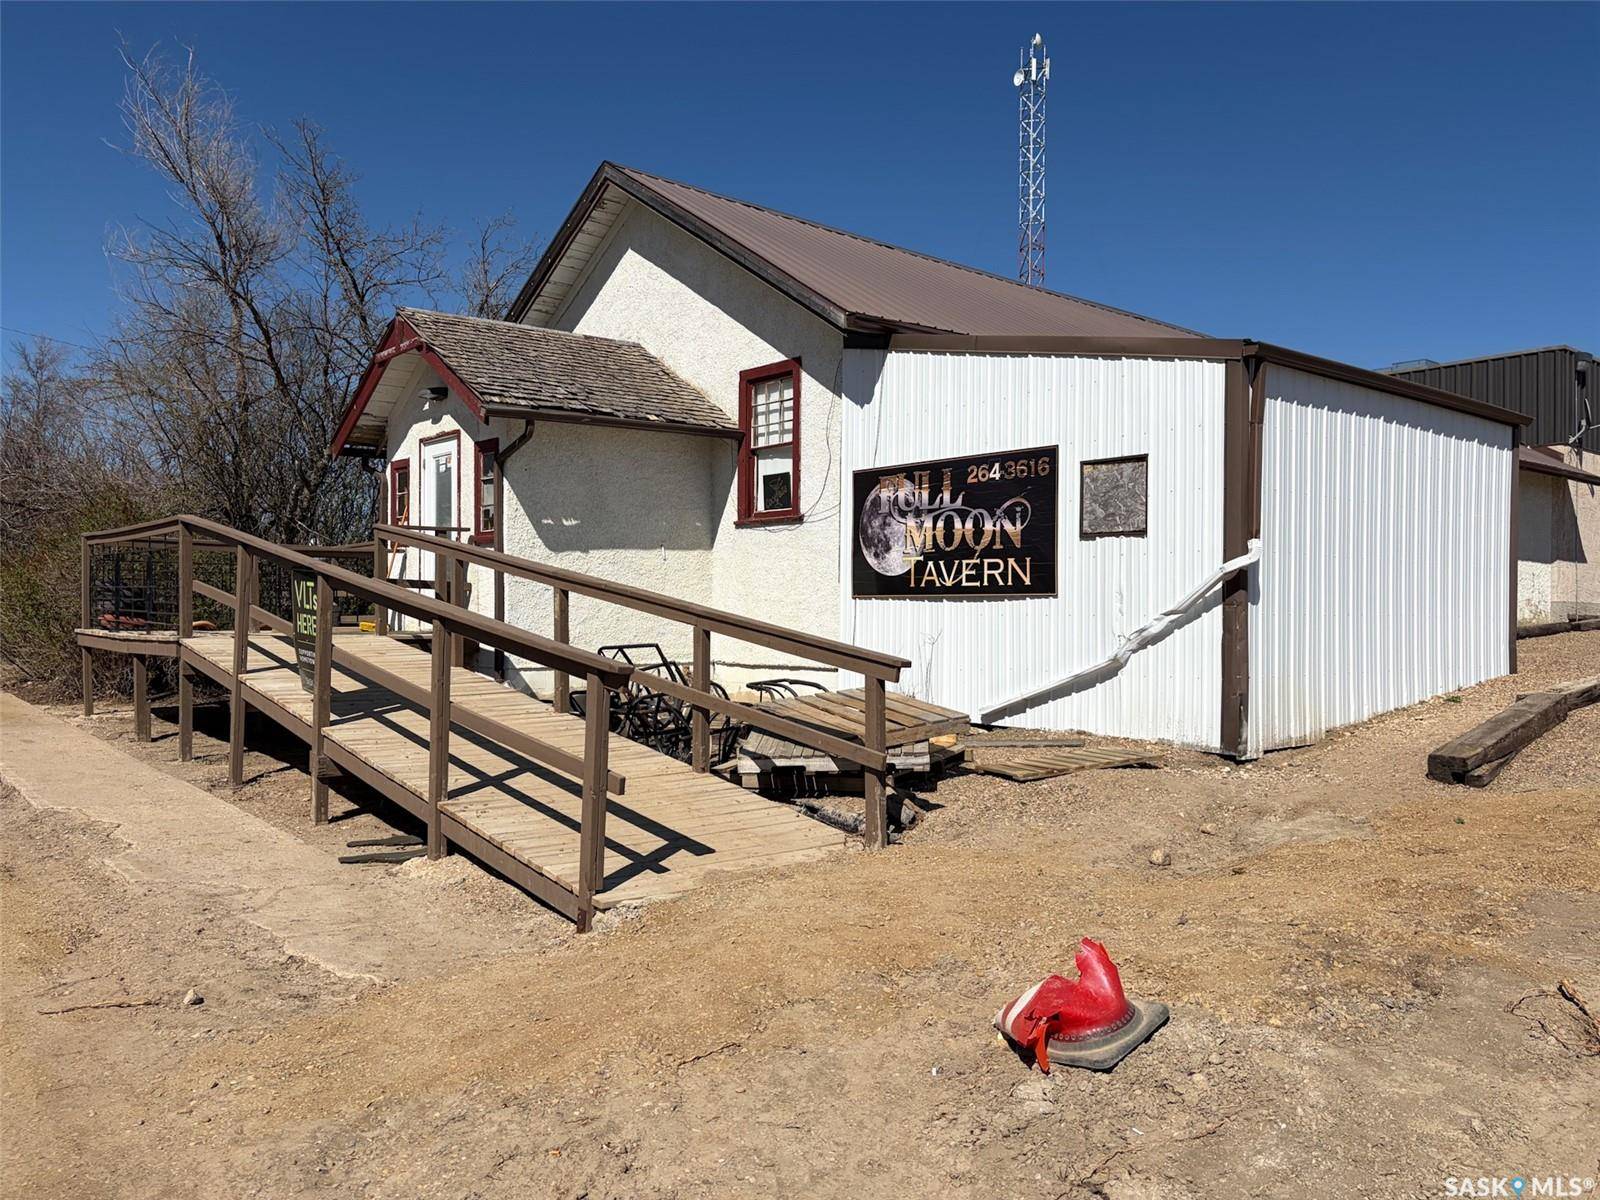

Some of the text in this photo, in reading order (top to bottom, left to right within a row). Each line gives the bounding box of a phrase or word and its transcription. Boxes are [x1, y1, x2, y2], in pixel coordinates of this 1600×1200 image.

[878, 467, 966, 514] FULL
[903, 500, 1029, 555] MOON
[902, 556, 1032, 588] TAVERN
[294, 579, 318, 610] VLTs
[296, 612, 317, 636] HERE
